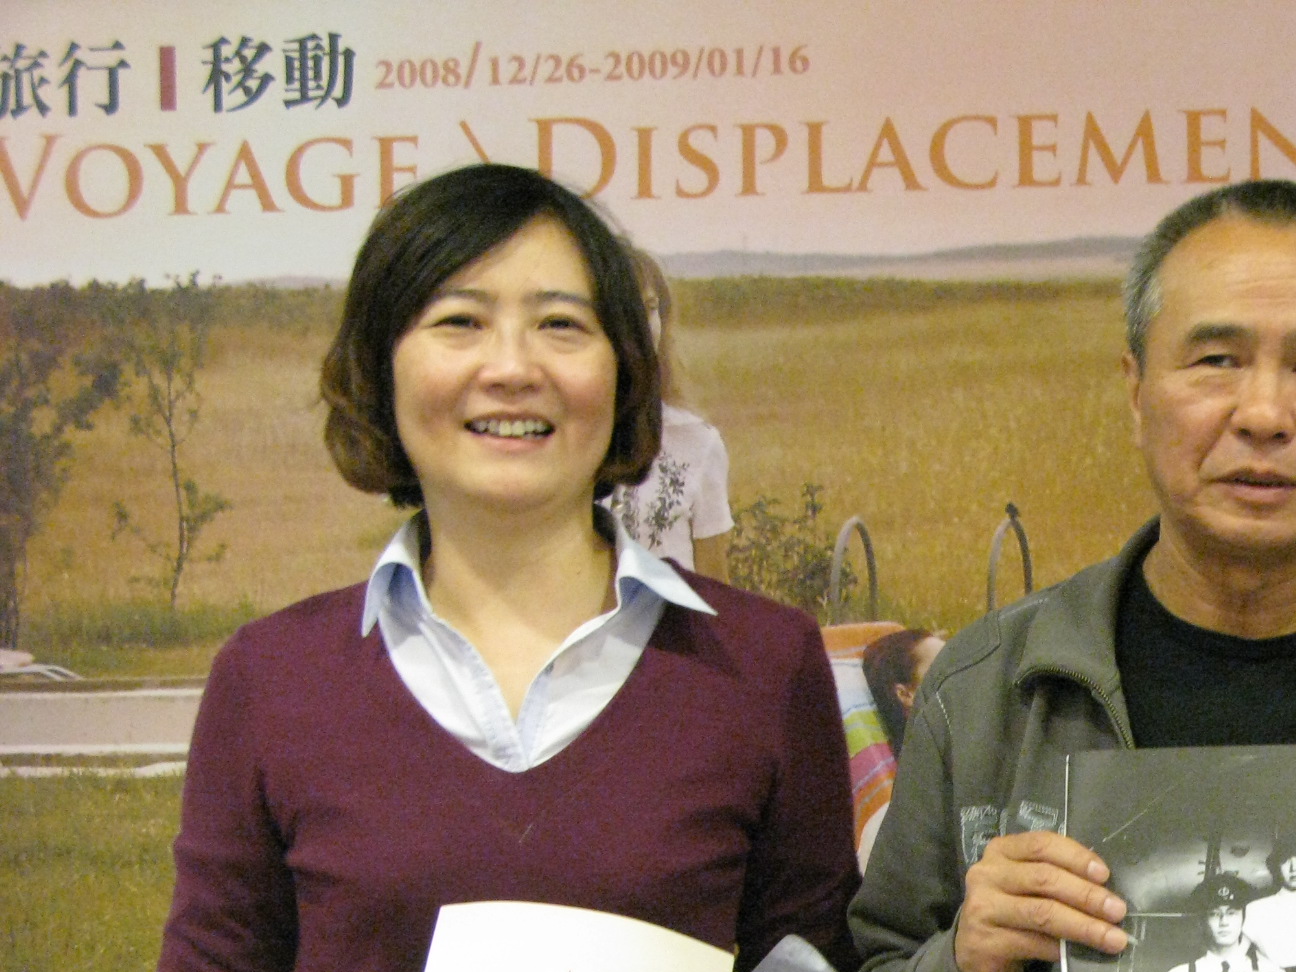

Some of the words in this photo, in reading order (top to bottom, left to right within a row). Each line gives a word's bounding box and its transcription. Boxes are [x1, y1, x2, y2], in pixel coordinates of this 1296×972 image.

[0, 39, 132, 120] 旅行
[202, 32, 357, 114] 移動
[374, 41, 811, 90] 2008/12/26-2009/01/16
[0, 132, 420, 222] VOYAGE
